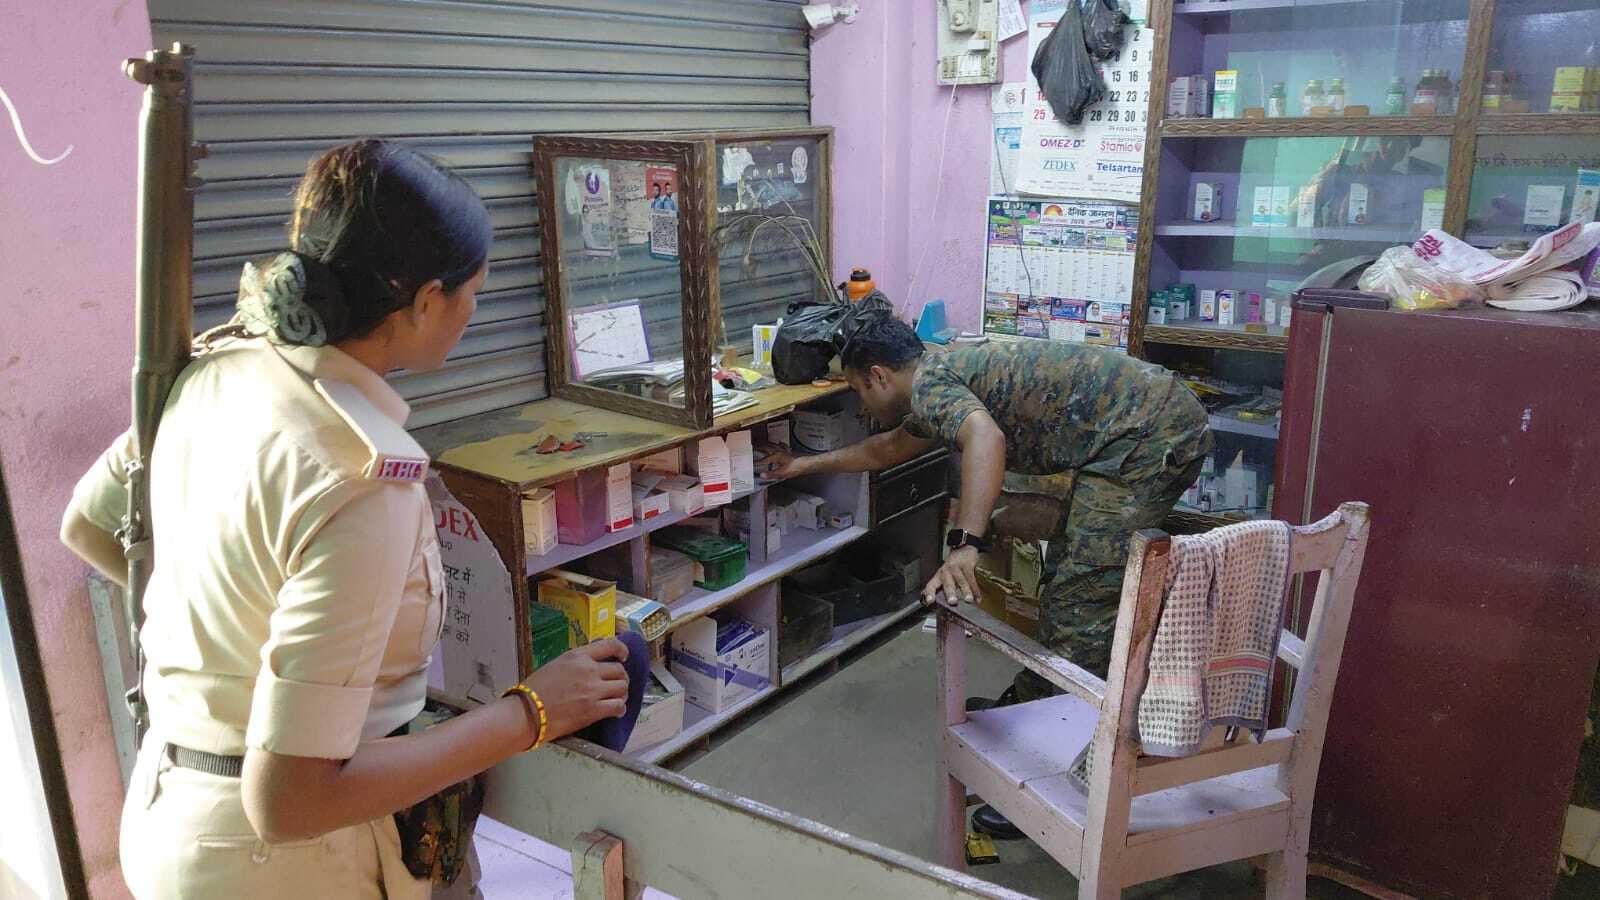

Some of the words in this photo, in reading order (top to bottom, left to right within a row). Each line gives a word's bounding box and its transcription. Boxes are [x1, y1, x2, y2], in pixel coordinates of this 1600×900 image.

[1112, 71, 1121, 82] 15
[1129, 70, 1138, 82] 16
[1109, 91, 1120, 102] 22
[1126, 90, 1137, 102] 23
[1033, 109, 1046, 121] 25
[1090, 111, 1102, 122] 28
[1107, 111, 1120, 122] 29
[1124, 110, 1136, 122] 30
